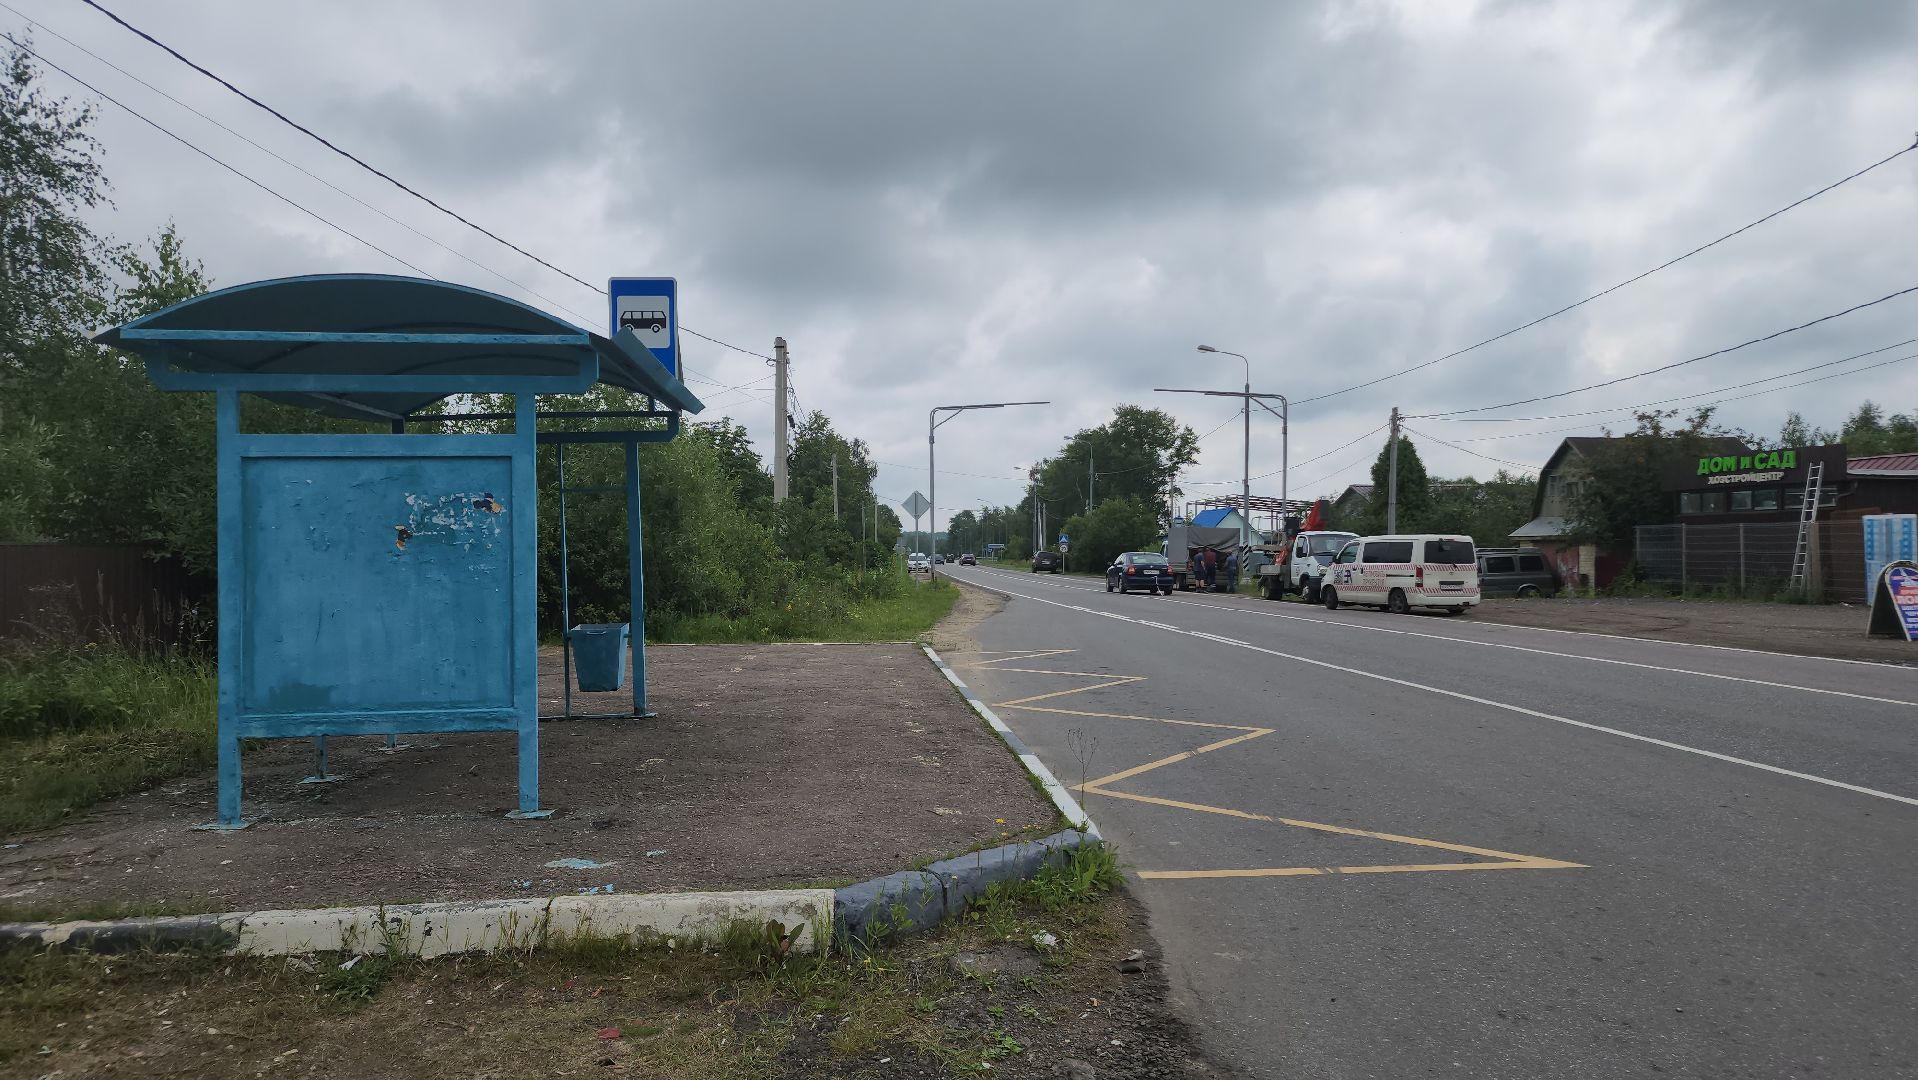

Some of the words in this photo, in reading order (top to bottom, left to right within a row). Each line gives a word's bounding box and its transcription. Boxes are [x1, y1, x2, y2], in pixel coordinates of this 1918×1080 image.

[1697, 456, 1737, 475] ДОМ
[1754, 450, 1797, 470] САД
[1708, 471, 1785, 484] ХОЗСТРОЙЦЕНТР
